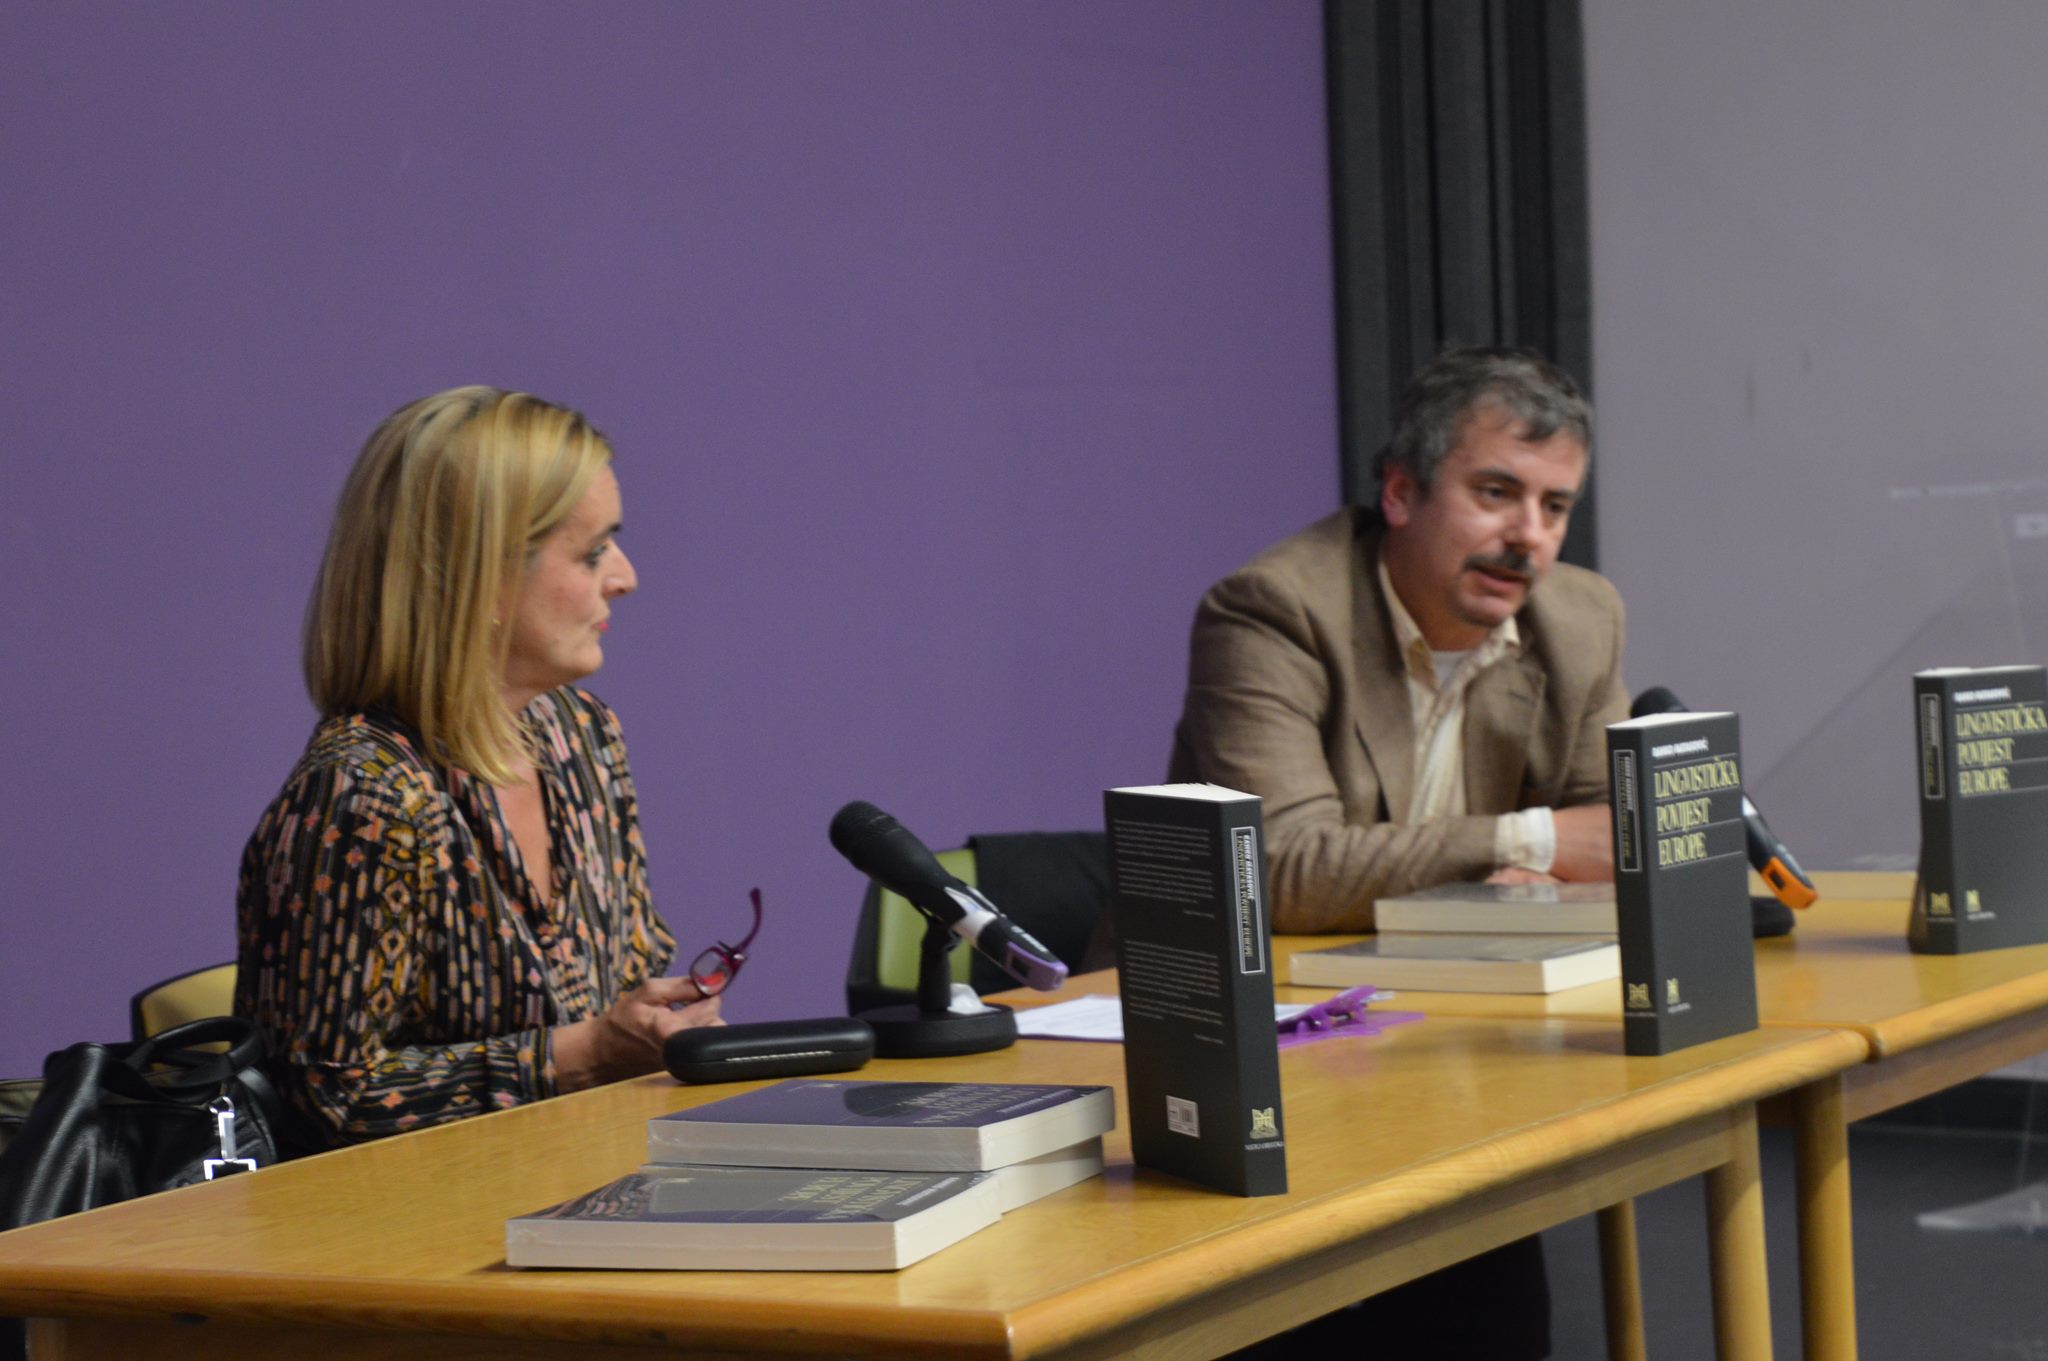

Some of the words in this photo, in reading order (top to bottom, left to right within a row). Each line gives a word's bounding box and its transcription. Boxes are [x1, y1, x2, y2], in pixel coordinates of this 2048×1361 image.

[1654, 756, 1740, 798] LINGVISTIČKA
[1656, 797, 1712, 832] POVIJEST
[1658, 832, 1708, 866] EUROPE
